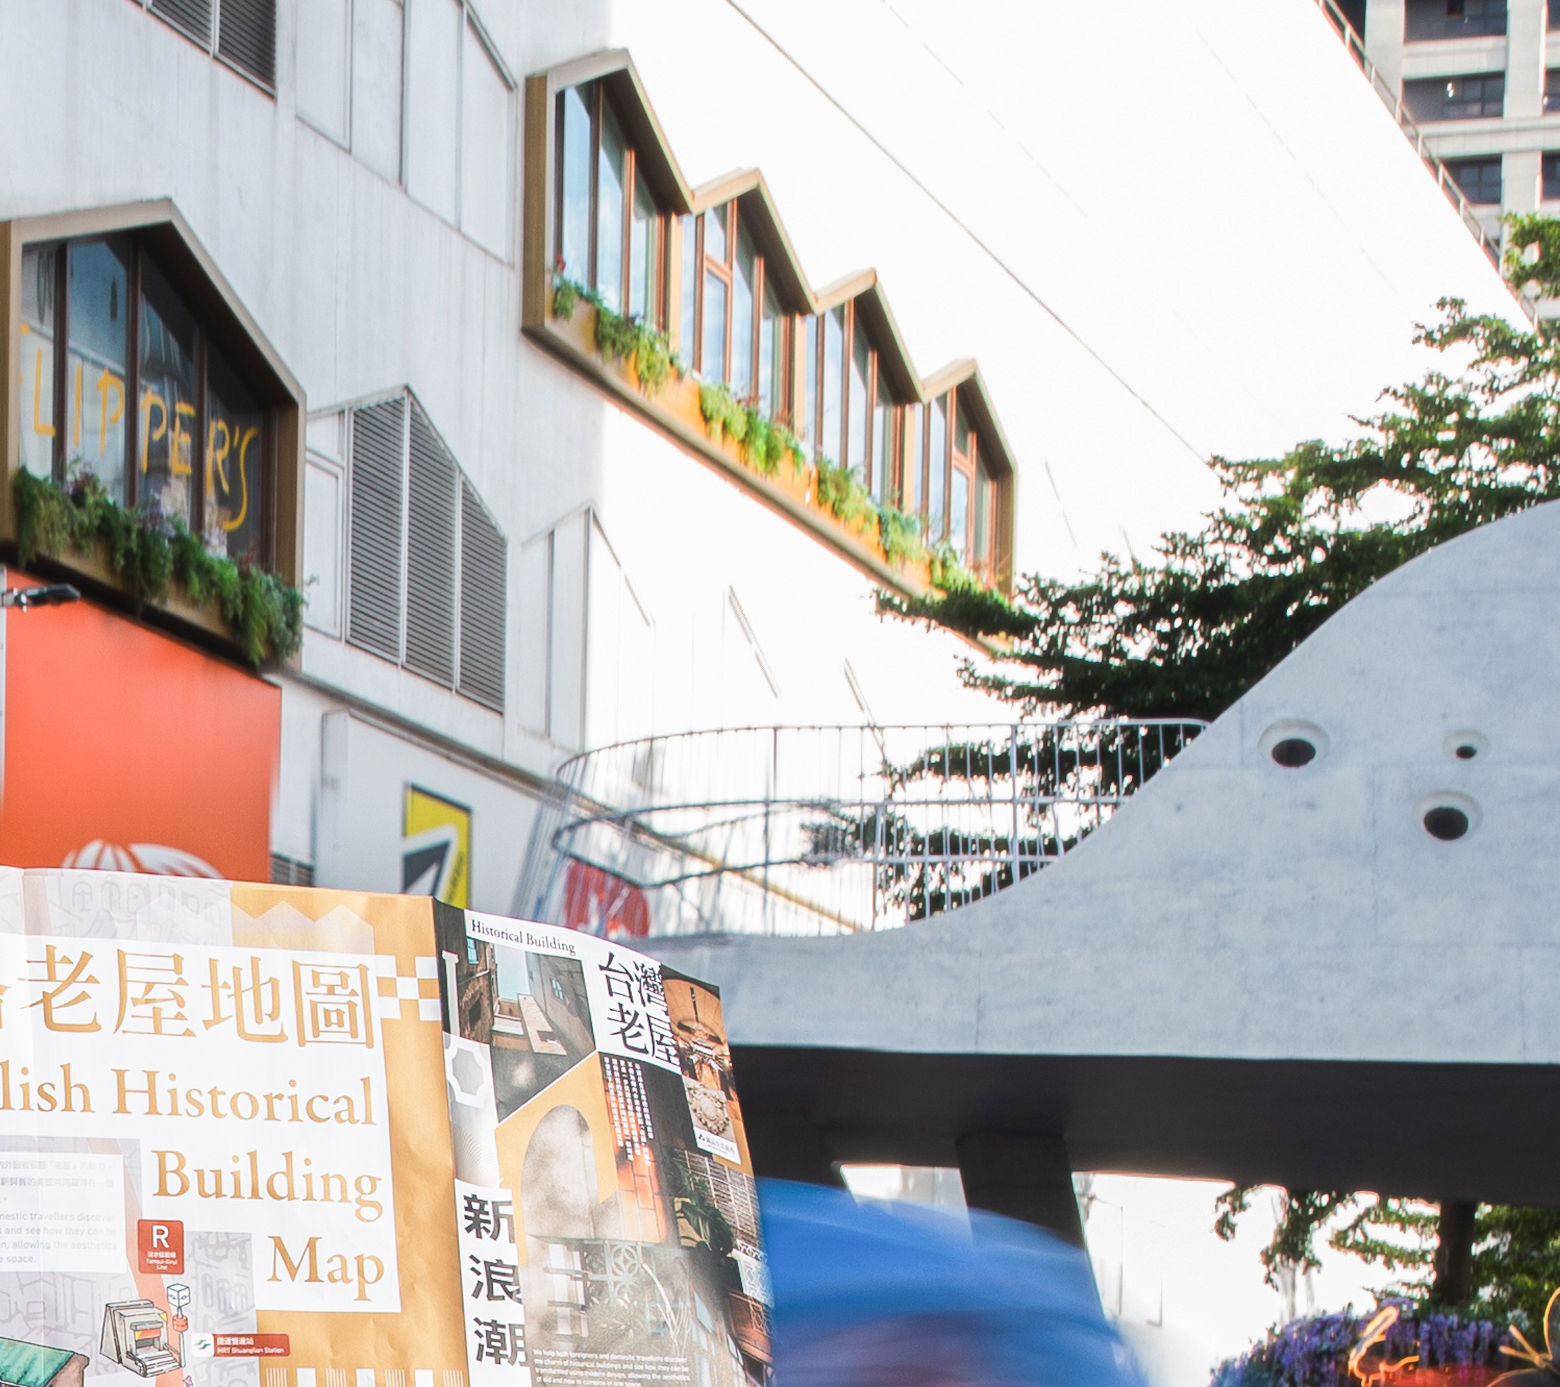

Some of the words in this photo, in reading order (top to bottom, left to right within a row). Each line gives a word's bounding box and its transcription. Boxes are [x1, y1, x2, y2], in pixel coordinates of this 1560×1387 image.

[20, 324, 258, 532] LIPPER'S
[472, 920, 524, 944] Historical
[526, 934, 576, 955] Building
[599, 952, 667, 1015] 台灣
[607, 1001, 681, 1068] 老屋
[111, 1068, 378, 1126] Historical
[152, 1148, 384, 1223] Building
[152, 1225, 169, 1248] R
[266, 1234, 384, 1302] Map
